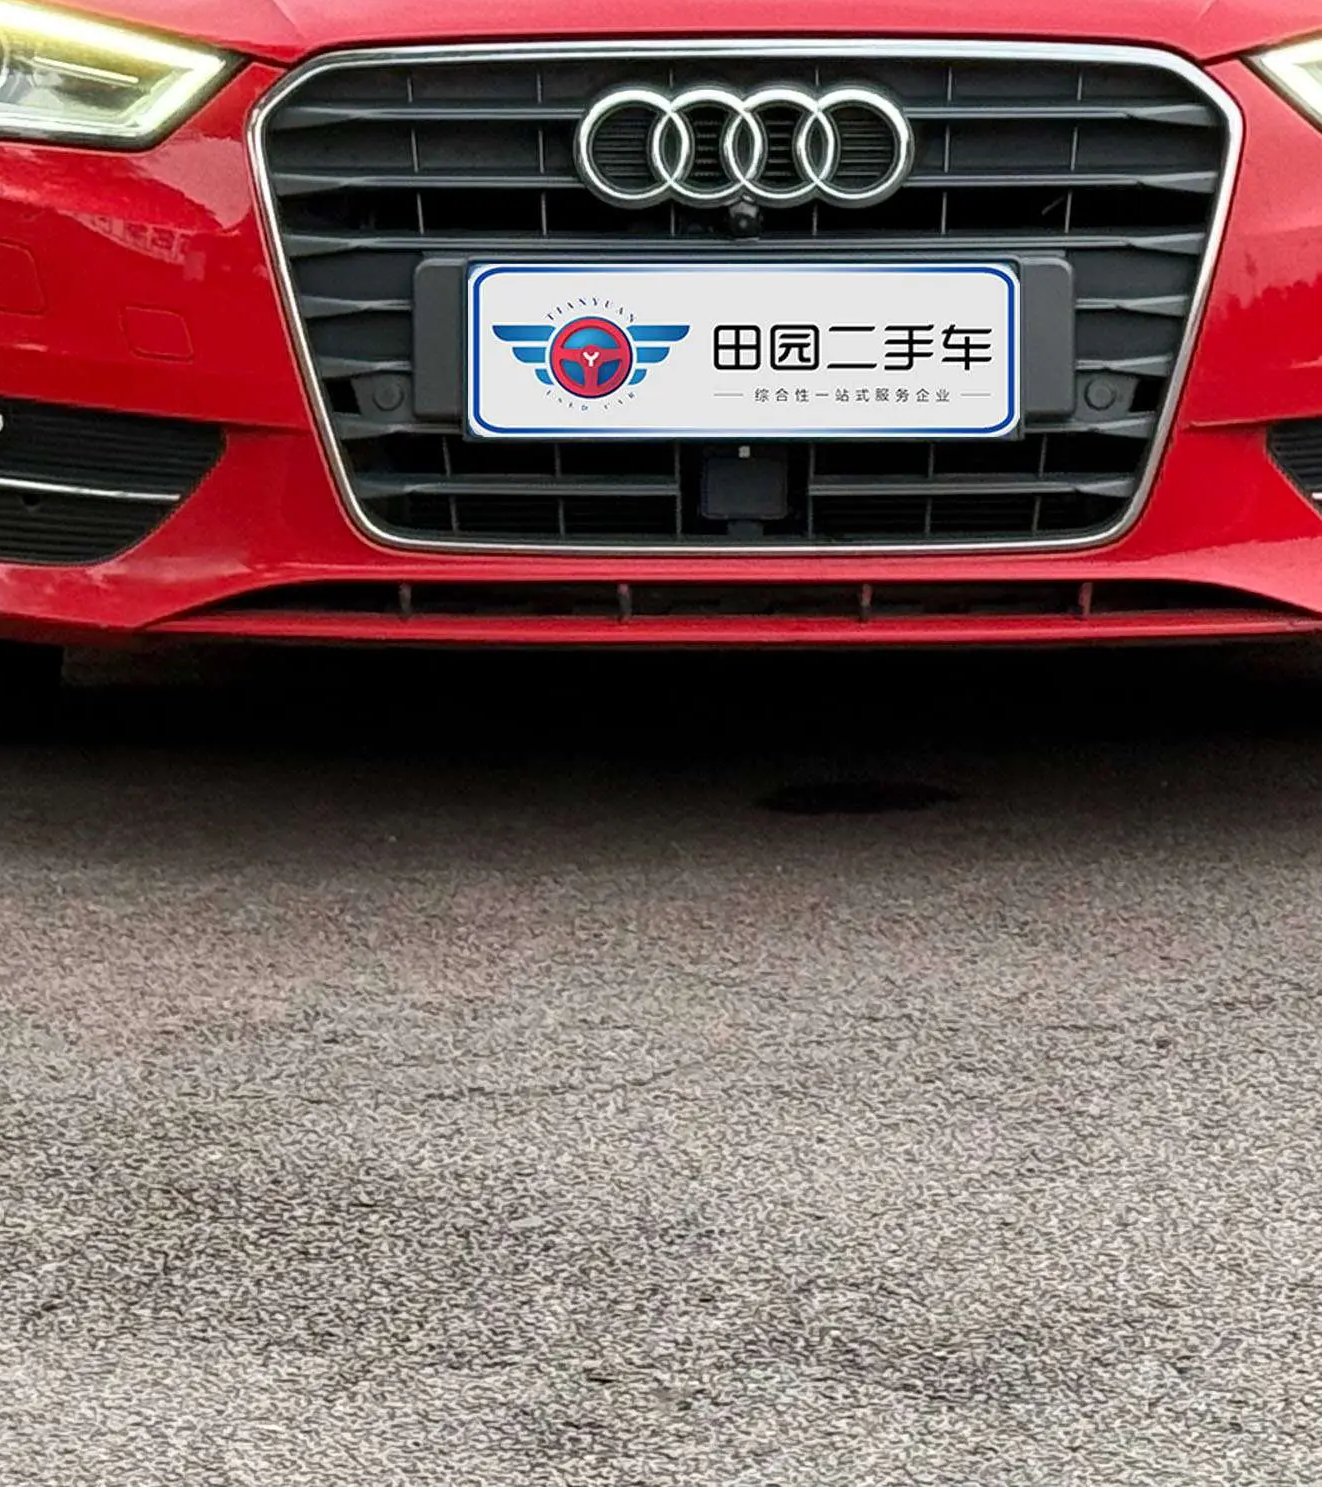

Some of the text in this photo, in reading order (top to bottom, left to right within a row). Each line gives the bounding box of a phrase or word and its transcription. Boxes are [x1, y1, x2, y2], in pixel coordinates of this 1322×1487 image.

[713, 324, 993, 370] 田园二手车
[754, 387, 950, 403] 综合性一站式服务企业
